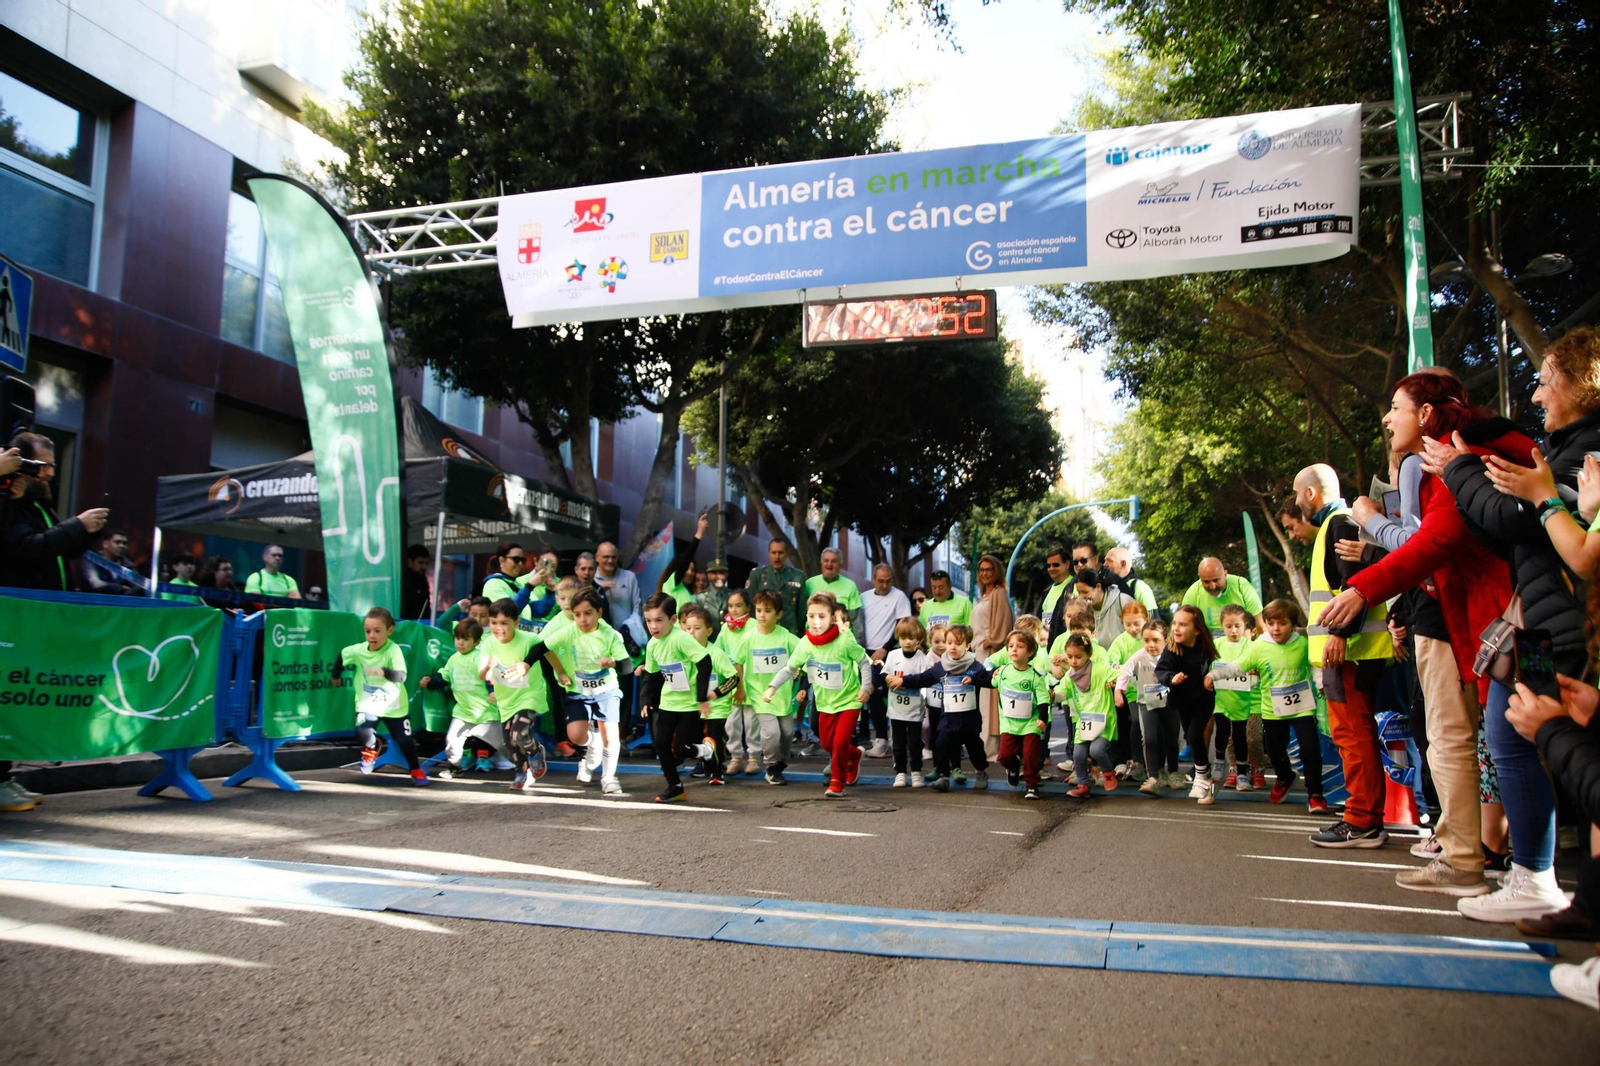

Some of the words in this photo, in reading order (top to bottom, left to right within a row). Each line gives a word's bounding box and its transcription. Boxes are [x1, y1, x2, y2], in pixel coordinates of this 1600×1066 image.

[1272, 128, 1343, 142] UNIVERSIDAD
[1273, 141, 1288, 150] DE
[1293, 134, 1344, 148] ALMERÍA
[1134, 142, 1212, 162] cajamar
[723, 172, 855, 211] Almería
[866, 170, 908, 194] en
[922, 153, 1061, 189] marcha
[1137, 194, 1191, 205] MICHELIN
[1211, 178, 1303, 200] Fundación
[1258, 203, 1290, 220] Ejido
[1293, 201, 1335, 213] Motor
[723, 216, 832, 248] contra
[843, 206, 877, 236] el
[886, 201, 1013, 232] cáncer
[1143, 225, 1181, 236] Toyota
[1279, 226, 1299, 234] Jeep
[1302, 222, 1318, 234] FIAT
[655, 233, 684, 247] SOLAN
[996, 236, 1040, 249] asociación
[1040, 235, 1077, 248] española
[1143, 236, 1187, 248] Alborán
[1190, 234, 1224, 244] Motor
[998, 247, 1023, 257] contra
[1024, 246, 1032, 255] el
[1032, 244, 1060, 255] cáncer
[998, 258, 1009, 266] en
[1010, 255, 1043, 265] Almería
[506, 268, 549, 282] ALMERÍA
[713, 268, 824, 286] #TodosContraElCáncer
[272, 659, 309, 676] Contra
[312, 661, 323, 674] el
[763, 656, 778, 666] 18
[8, 666, 31, 684] el
[36, 669, 106, 687] cáncer
[817, 669, 829, 681] 21
[309, 675, 332, 690] sol
[581, 678, 606, 688] 886
[0, 688, 50, 706] solo
[55, 692, 94, 707] uno
[371, 694, 387, 703] 24
[896, 695, 910, 706] 98
[952, 693, 967, 703] 17
[1009, 699, 1016, 709] 1
[1283, 693, 1301, 706] 32
[403, 719, 412, 736] 9
[1081, 721, 1092, 731] 31
